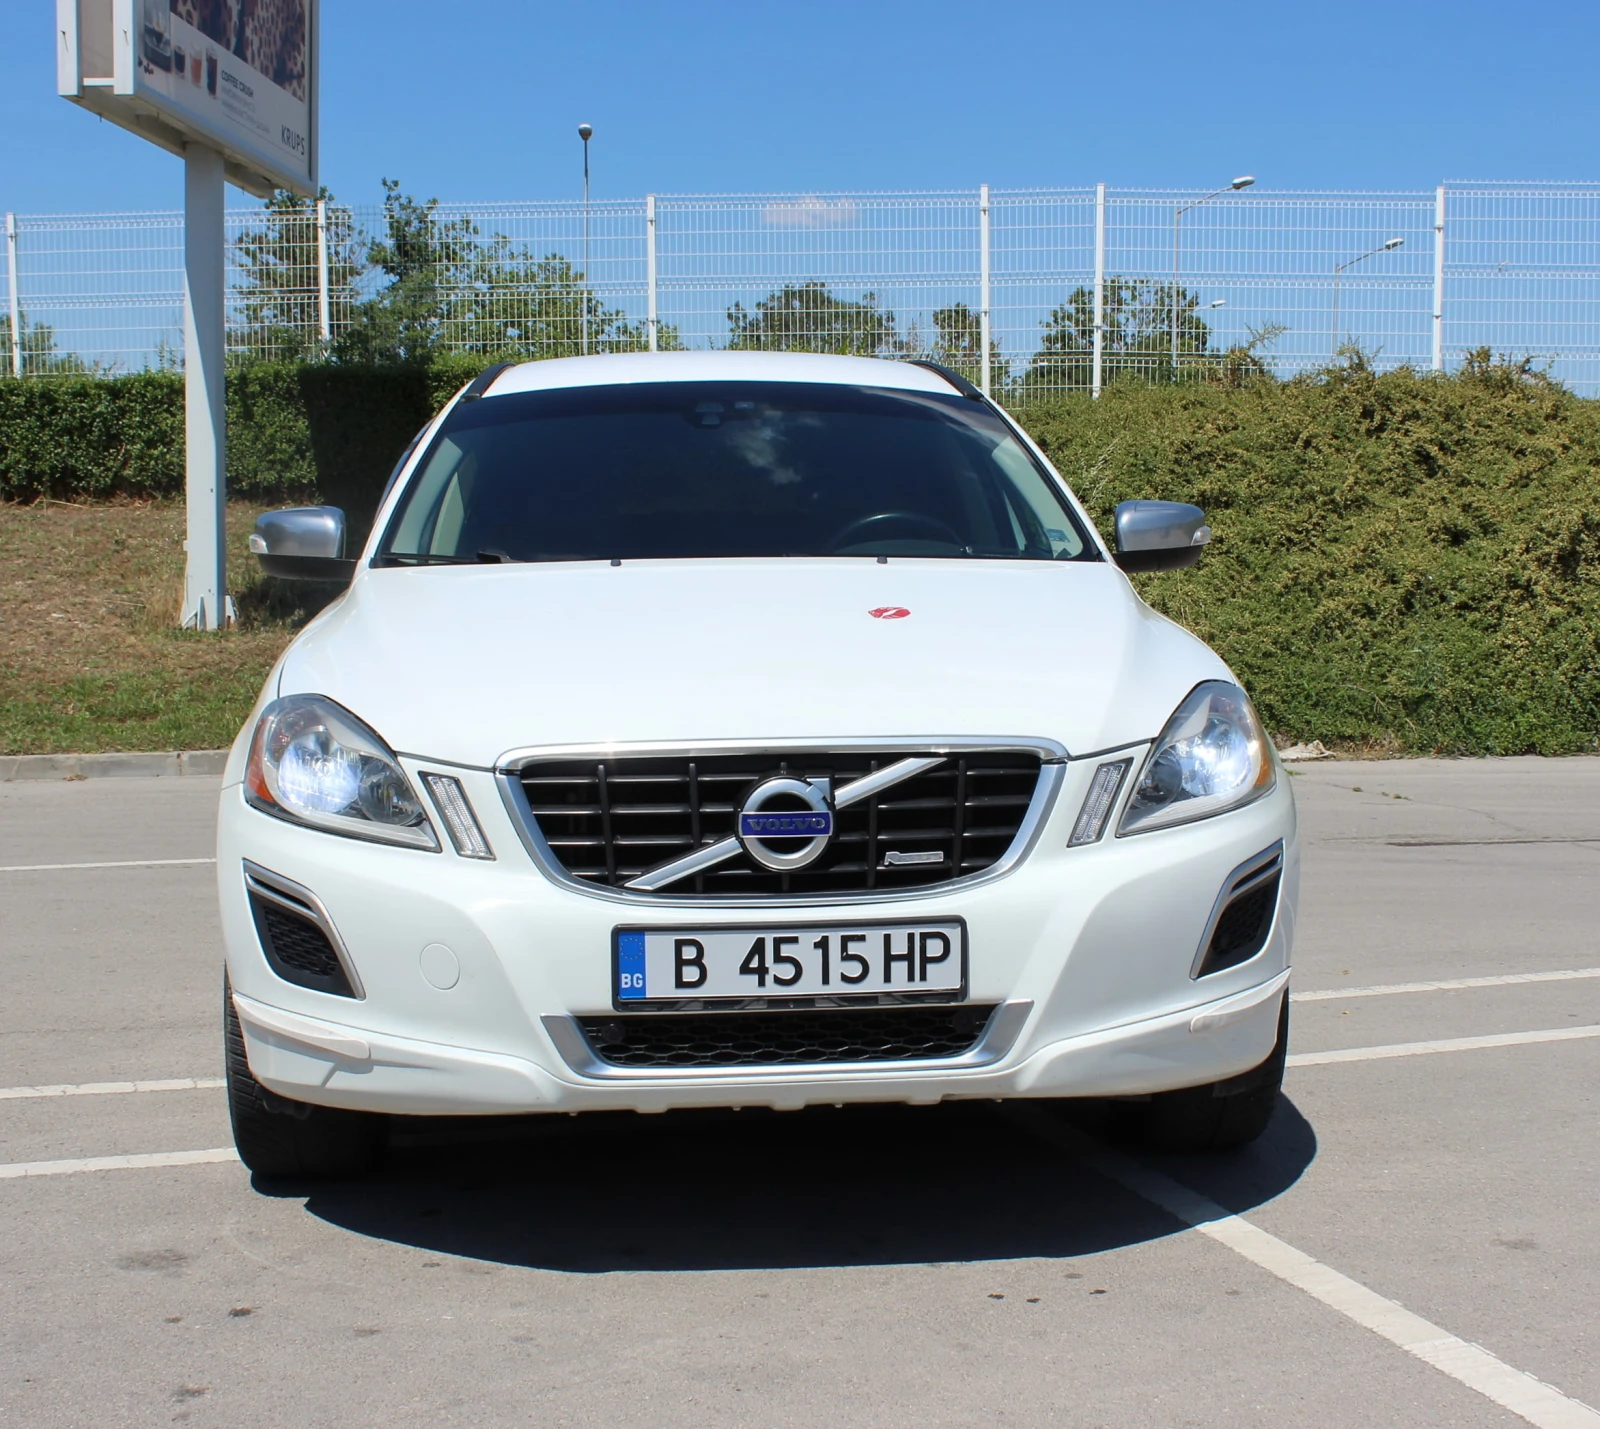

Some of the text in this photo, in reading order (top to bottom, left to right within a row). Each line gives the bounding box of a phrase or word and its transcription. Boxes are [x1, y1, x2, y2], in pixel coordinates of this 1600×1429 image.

[281, 124, 305, 155] KRUPS
[747, 818, 825, 831] VOLVO
[673, 938, 708, 989] B
[621, 973, 643, 988] BG
